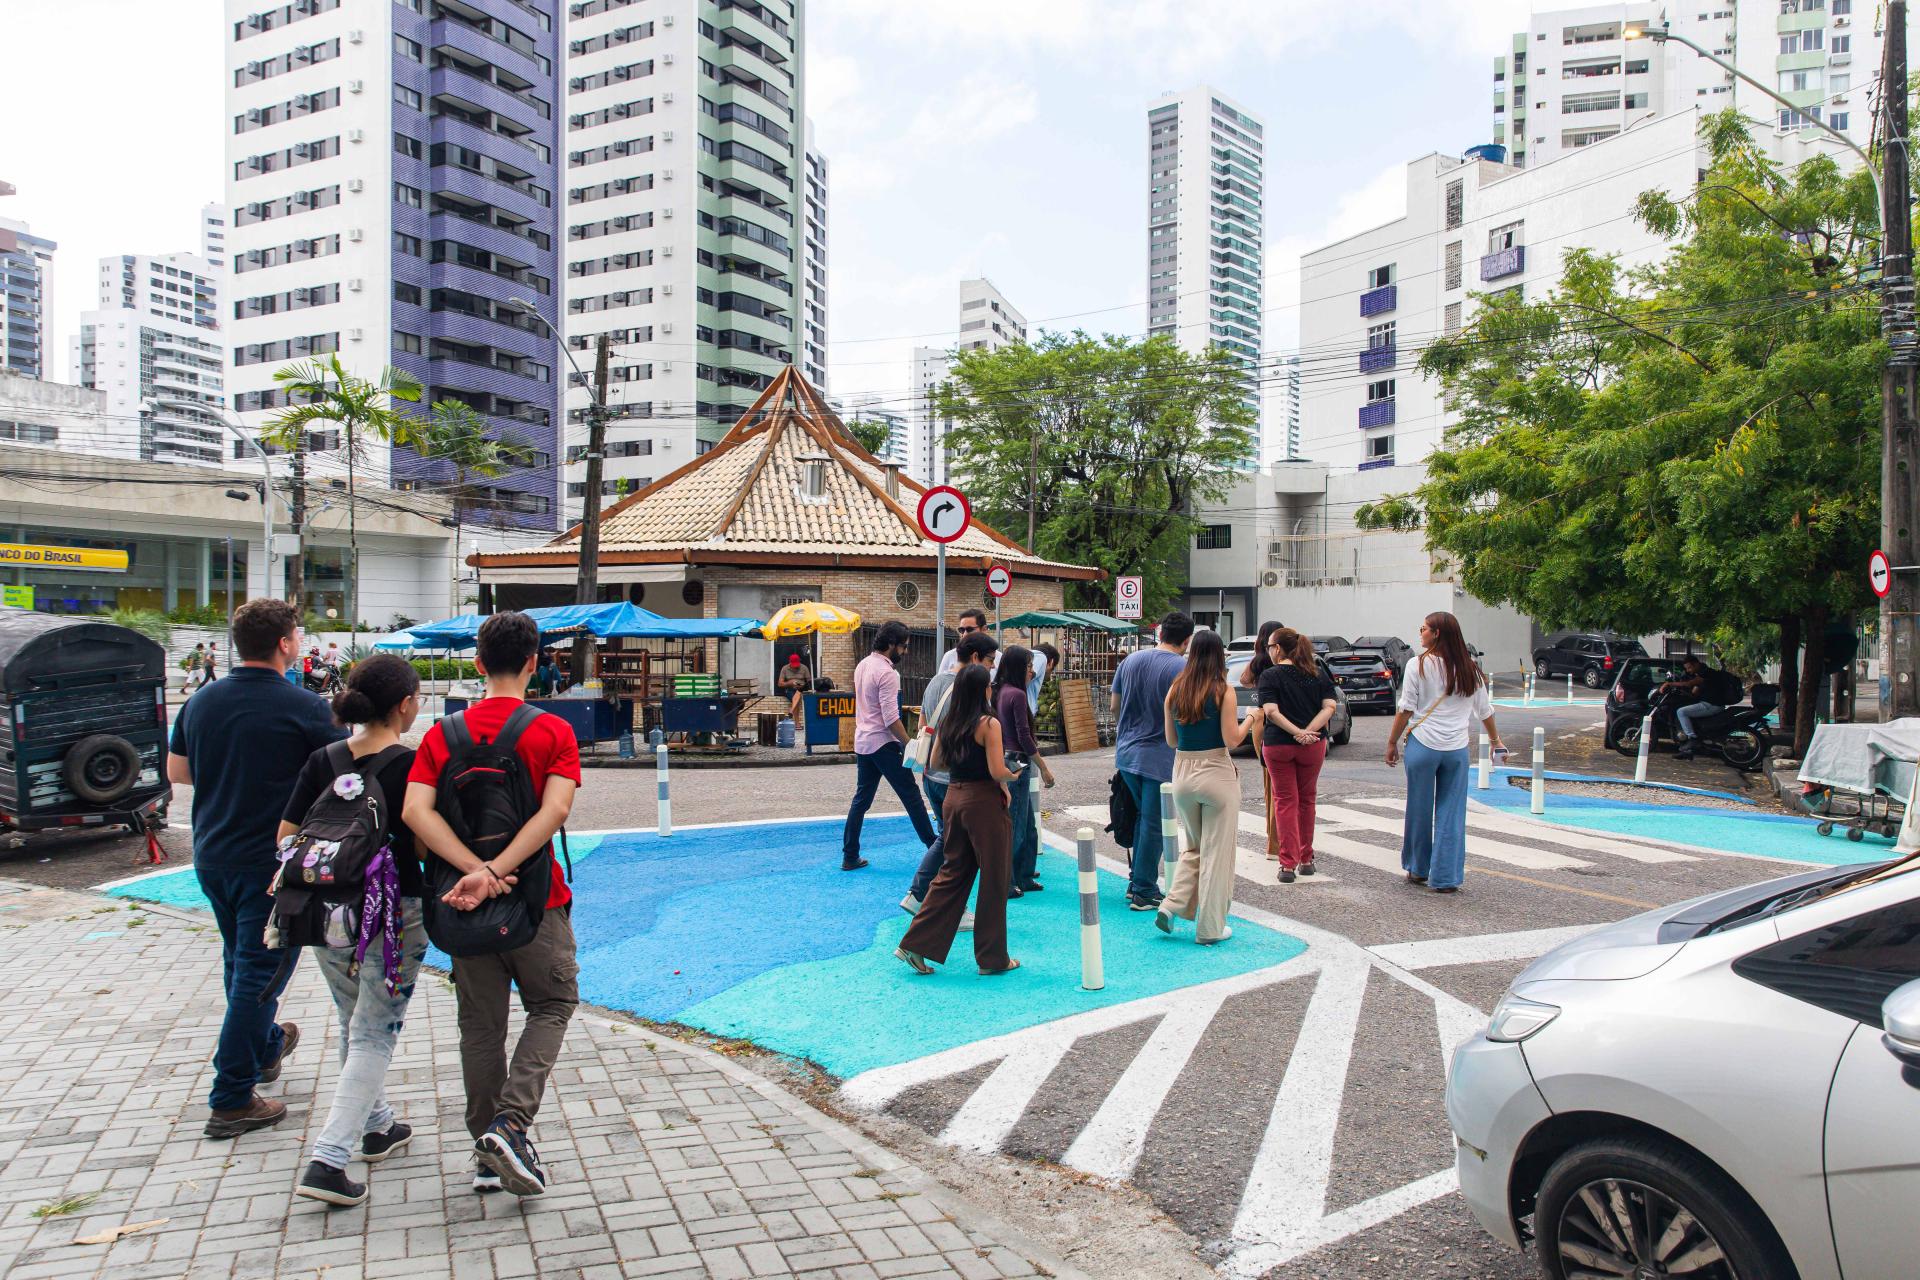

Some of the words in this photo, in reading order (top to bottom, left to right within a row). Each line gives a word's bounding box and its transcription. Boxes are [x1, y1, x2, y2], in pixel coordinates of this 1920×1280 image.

[24, 551, 40, 560] DO
[44, 550, 82, 563] BRASIL
[1126, 584, 1133, 594] E
[1120, 601, 1139, 610] TÁXI
[819, 698, 856, 715] CHAV
